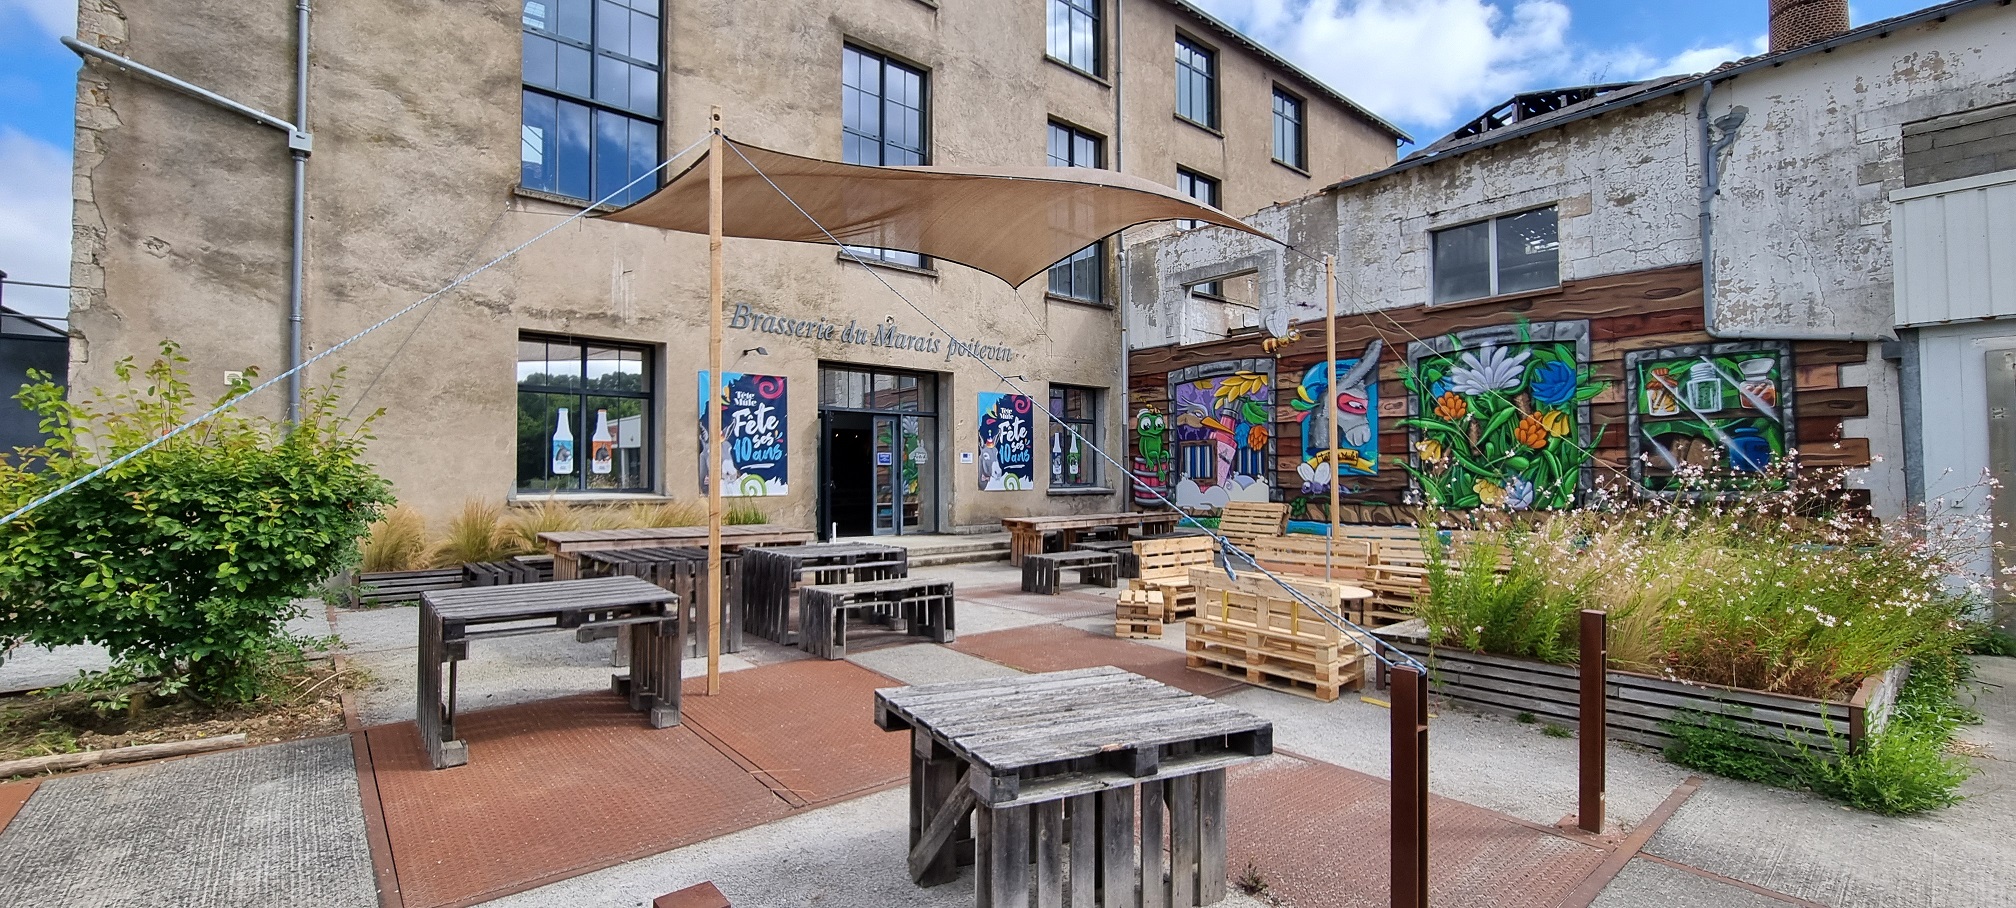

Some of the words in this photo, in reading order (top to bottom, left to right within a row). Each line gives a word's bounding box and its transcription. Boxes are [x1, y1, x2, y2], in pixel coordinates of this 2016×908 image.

[728, 302, 835, 341] Brasserie
[841, 319, 869, 345] du
[871, 323, 942, 354] Marais
[944, 336, 1013, 363] poitevin
[734, 390, 756, 400] Tête
[731, 402, 780, 438] Fête
[998, 416, 1028, 444] Fête
[733, 436, 753, 463] 10
[752, 443, 784, 462] ans
[752, 431, 775, 449] ses
[1010, 439, 1025, 453] ses
[999, 443, 1011, 465] 10
[1011, 449, 1030, 464] ans
